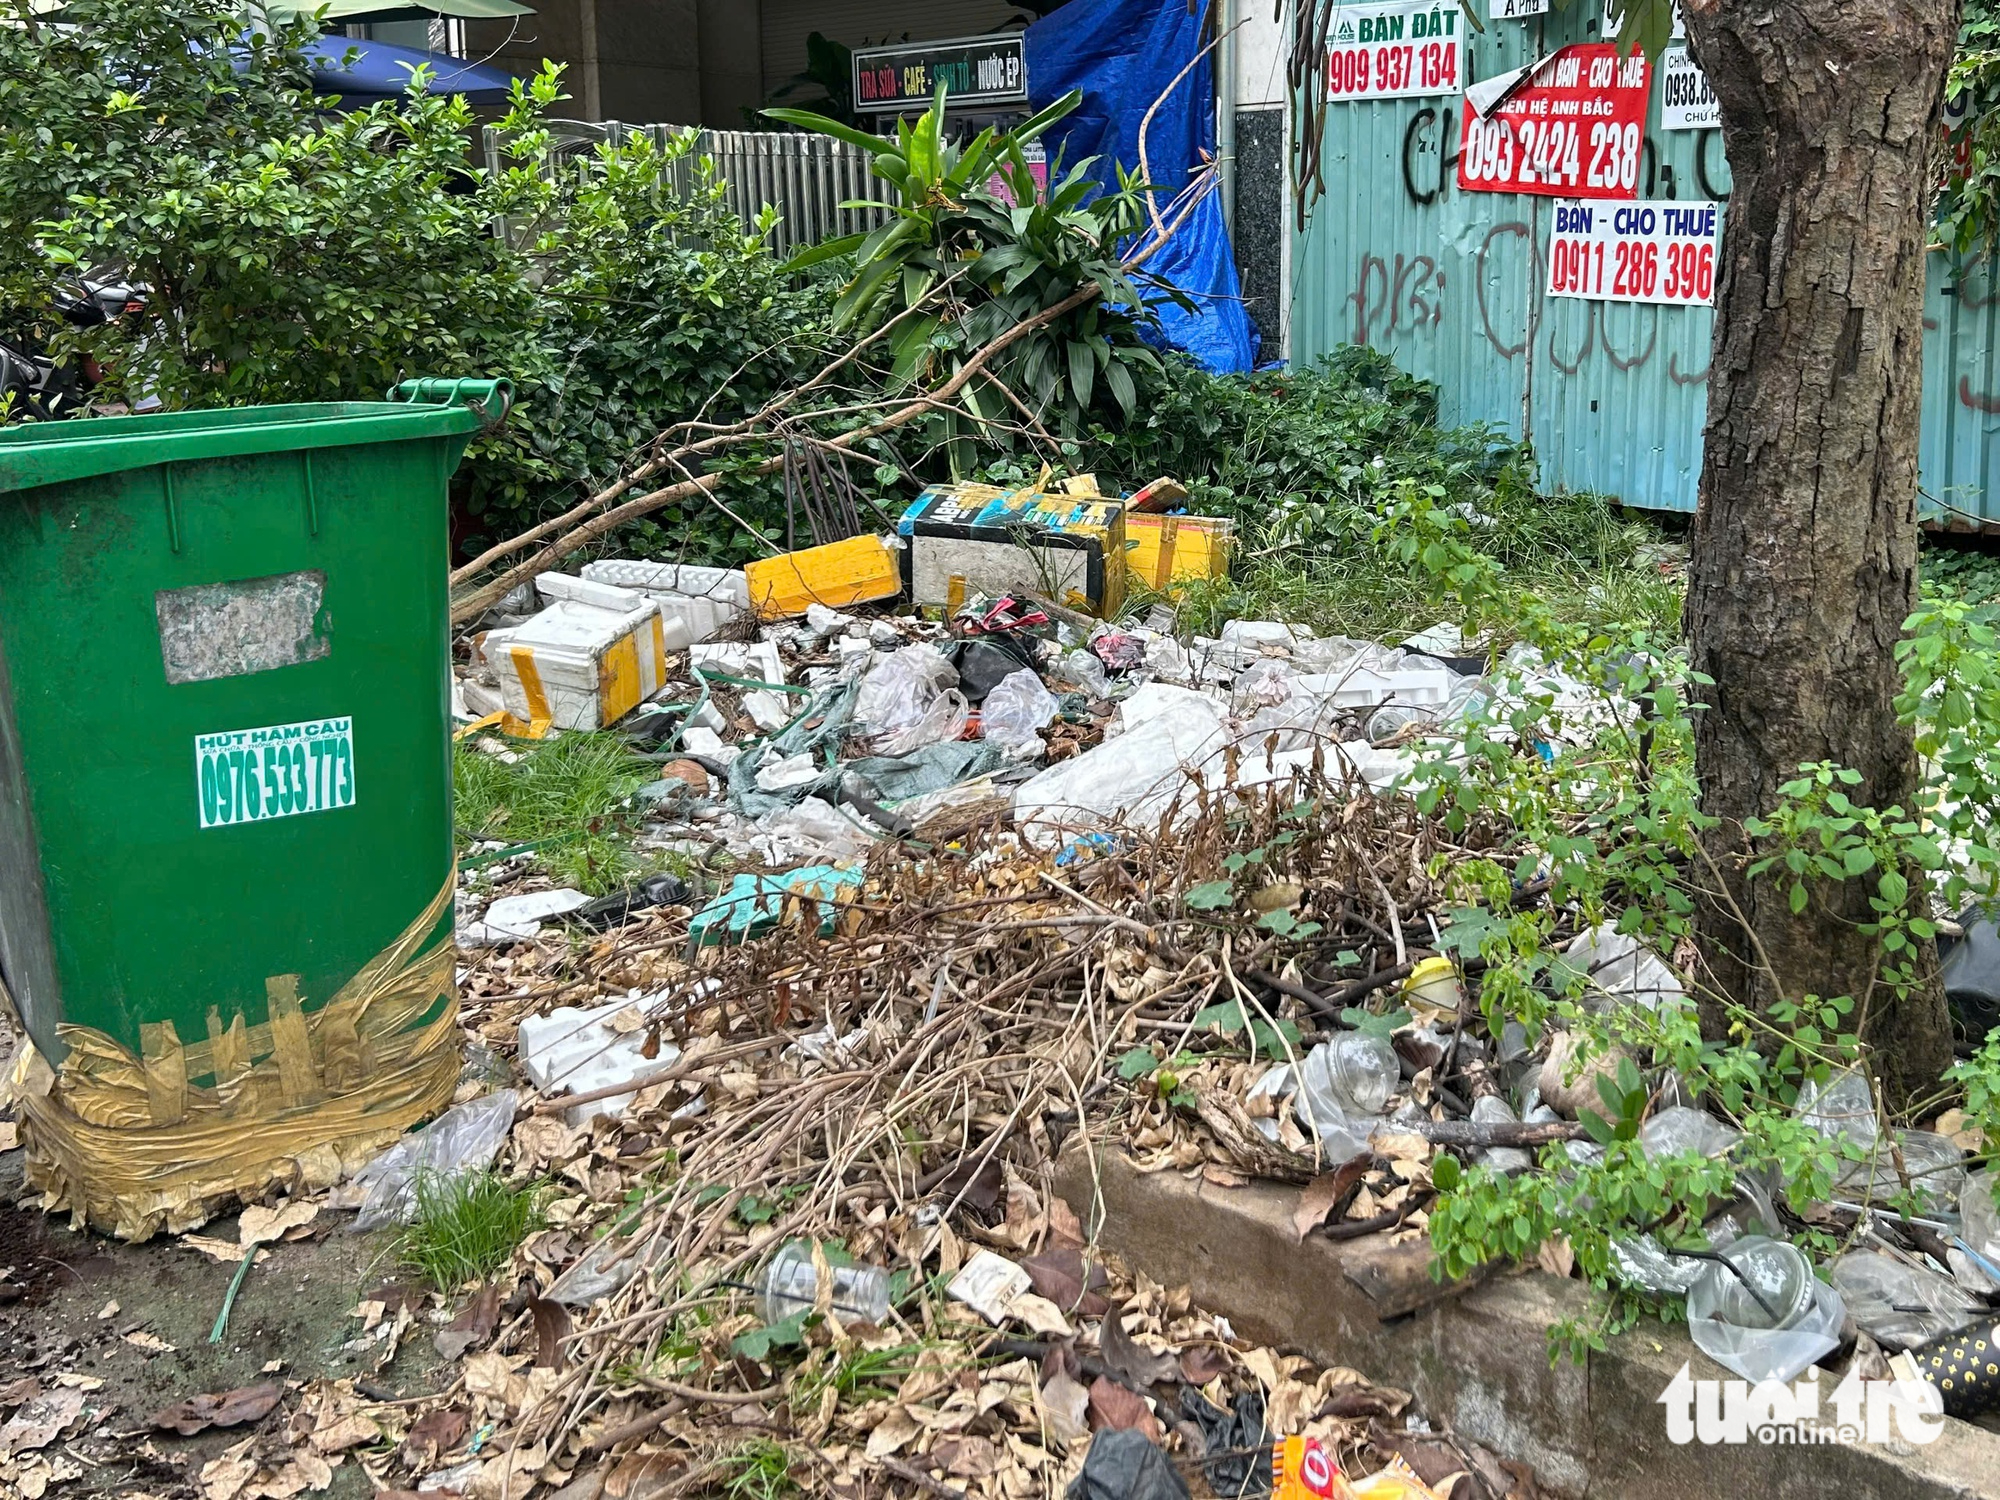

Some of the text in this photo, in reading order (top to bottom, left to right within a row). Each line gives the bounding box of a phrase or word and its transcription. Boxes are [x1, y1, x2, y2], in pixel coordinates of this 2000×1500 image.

[1359, 2, 1459, 43] BÁN ĐẤT
[860, 64, 877, 99] TRÀ
[904, 59, 926, 96] CAFÉ
[977, 52, 1004, 90] NƯỚC
[1006, 51, 1019, 88] ÉP
[1331, 42, 1456, 94] 909 937 134
[1555, 51, 1580, 88] BÁN
[1589, 57, 1613, 88] CHO
[1497, 96, 1613, 117] IÊN HỆ ANH BẮC
[1464, 118, 1514, 182] 093
[1518, 120, 1579, 186] 2424
[1587, 122, 1639, 190] 238
[1556, 201, 1592, 234] BÁN
[1614, 208, 1655, 236] CHO
[1663, 203, 1715, 237] THUÊ
[1553, 238, 1713, 300] 0911 286 396
[200, 720, 349, 749] HÚT HẦM CẦU
[202, 737, 352, 825] 0976.533.773
